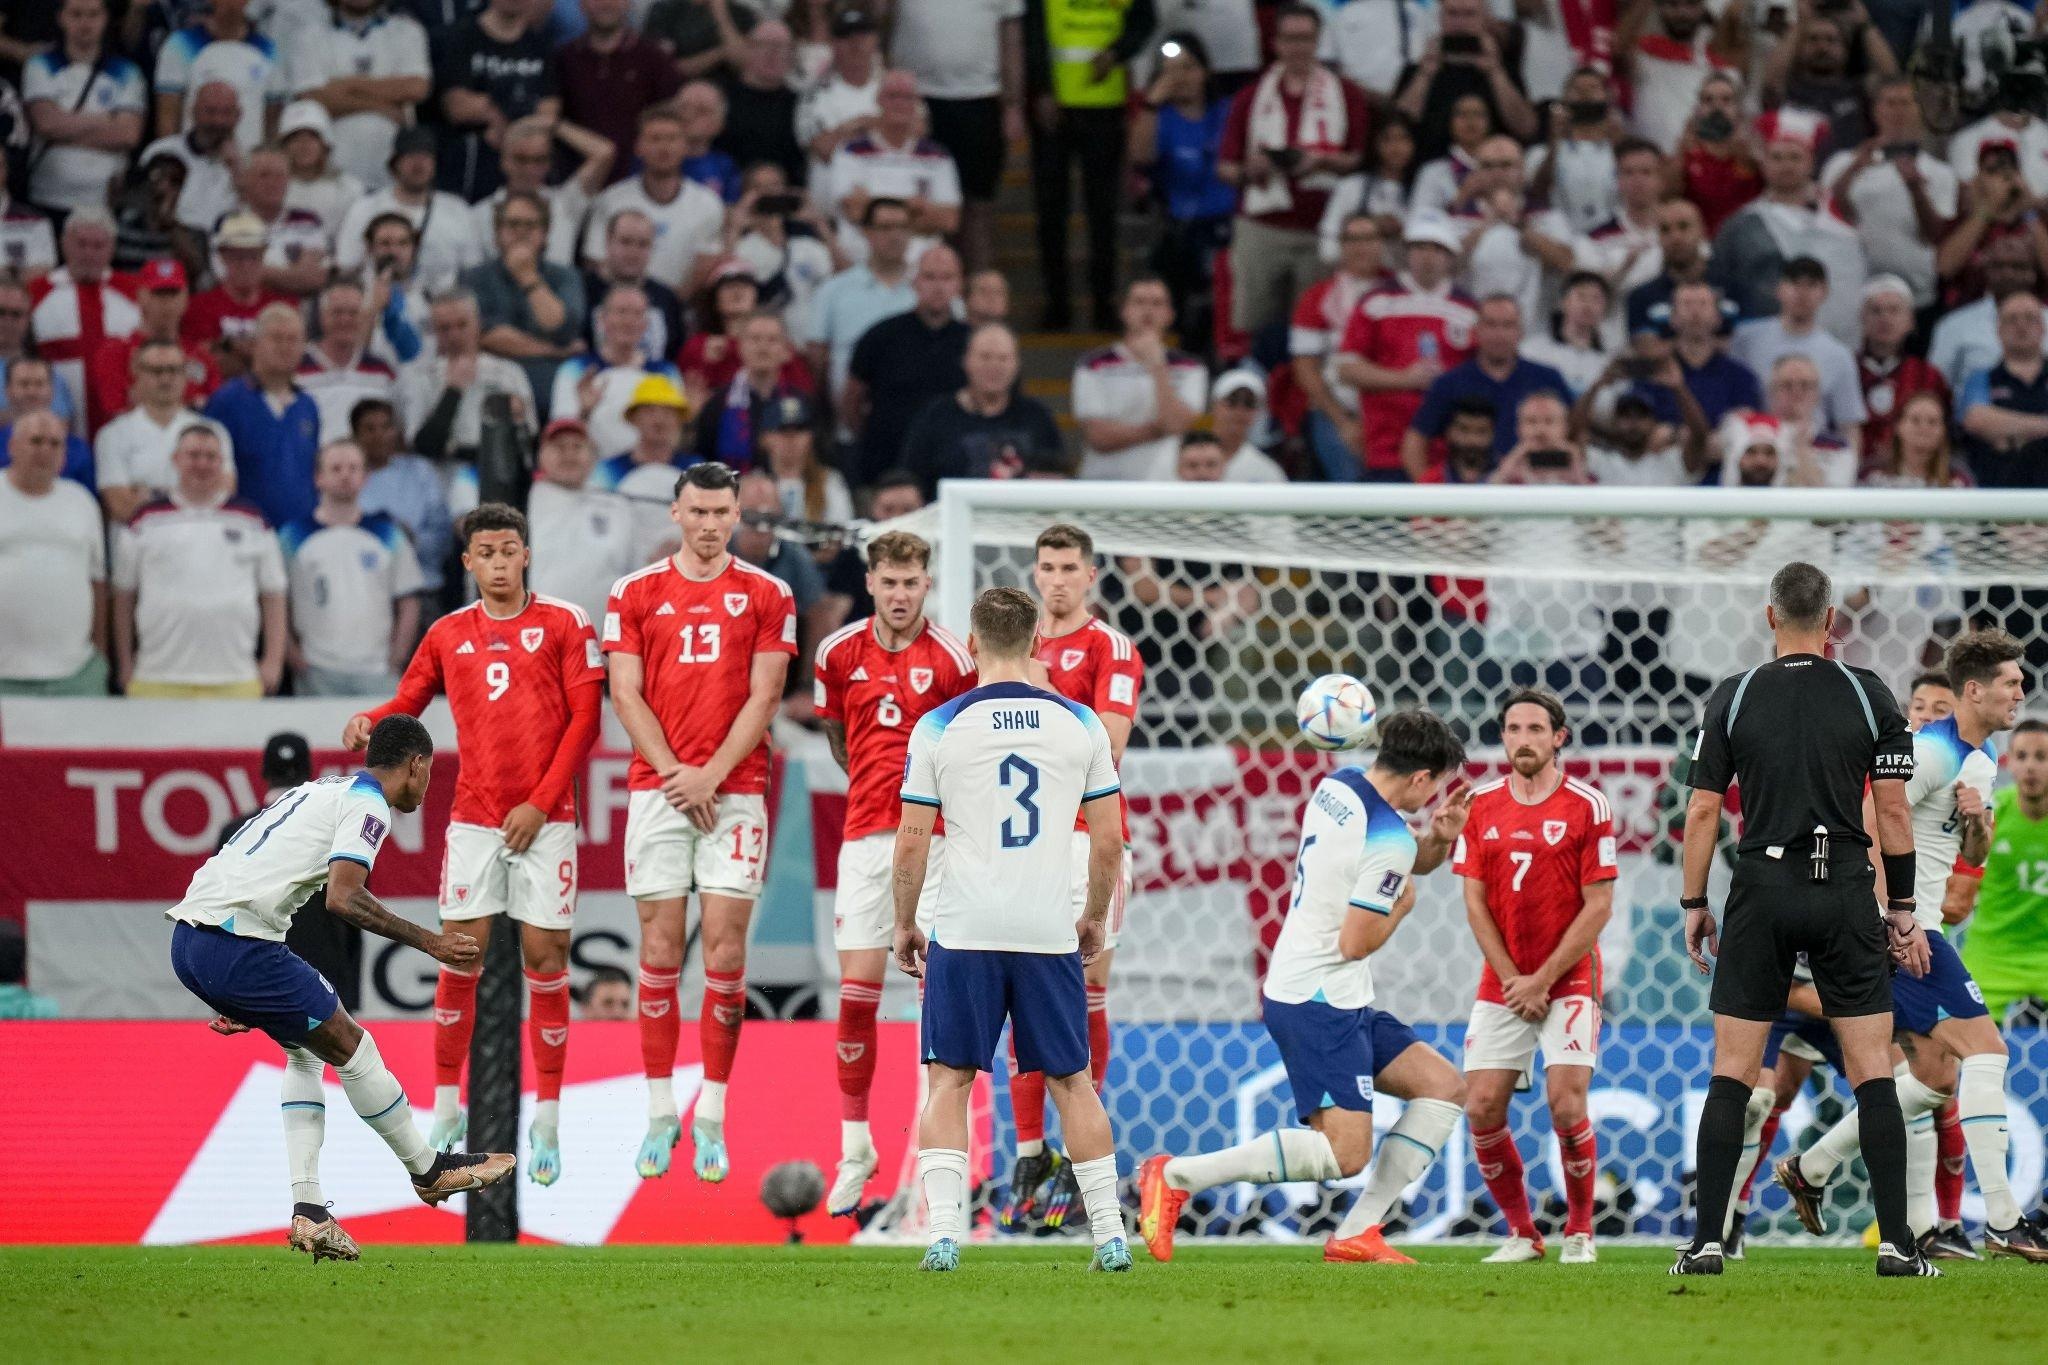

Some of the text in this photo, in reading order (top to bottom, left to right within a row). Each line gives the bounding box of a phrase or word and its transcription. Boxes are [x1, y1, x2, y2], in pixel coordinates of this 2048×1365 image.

[678, 624, 721, 663] 13
[486, 662, 510, 701] 9
[876, 694, 901, 727] 6
[992, 710, 1041, 730] SHAW
[1875, 754, 1914, 766] FIFA
[999, 752, 1041, 848] 3
[1314, 788, 1354, 827] MAGUIRE
[228, 790, 310, 856] 11
[730, 824, 764, 864] 13
[558, 860, 573, 897] 9
[1509, 851, 1533, 892] 7
[2016, 860, 2048, 896] 12
[1564, 1000, 1584, 1034] 7
